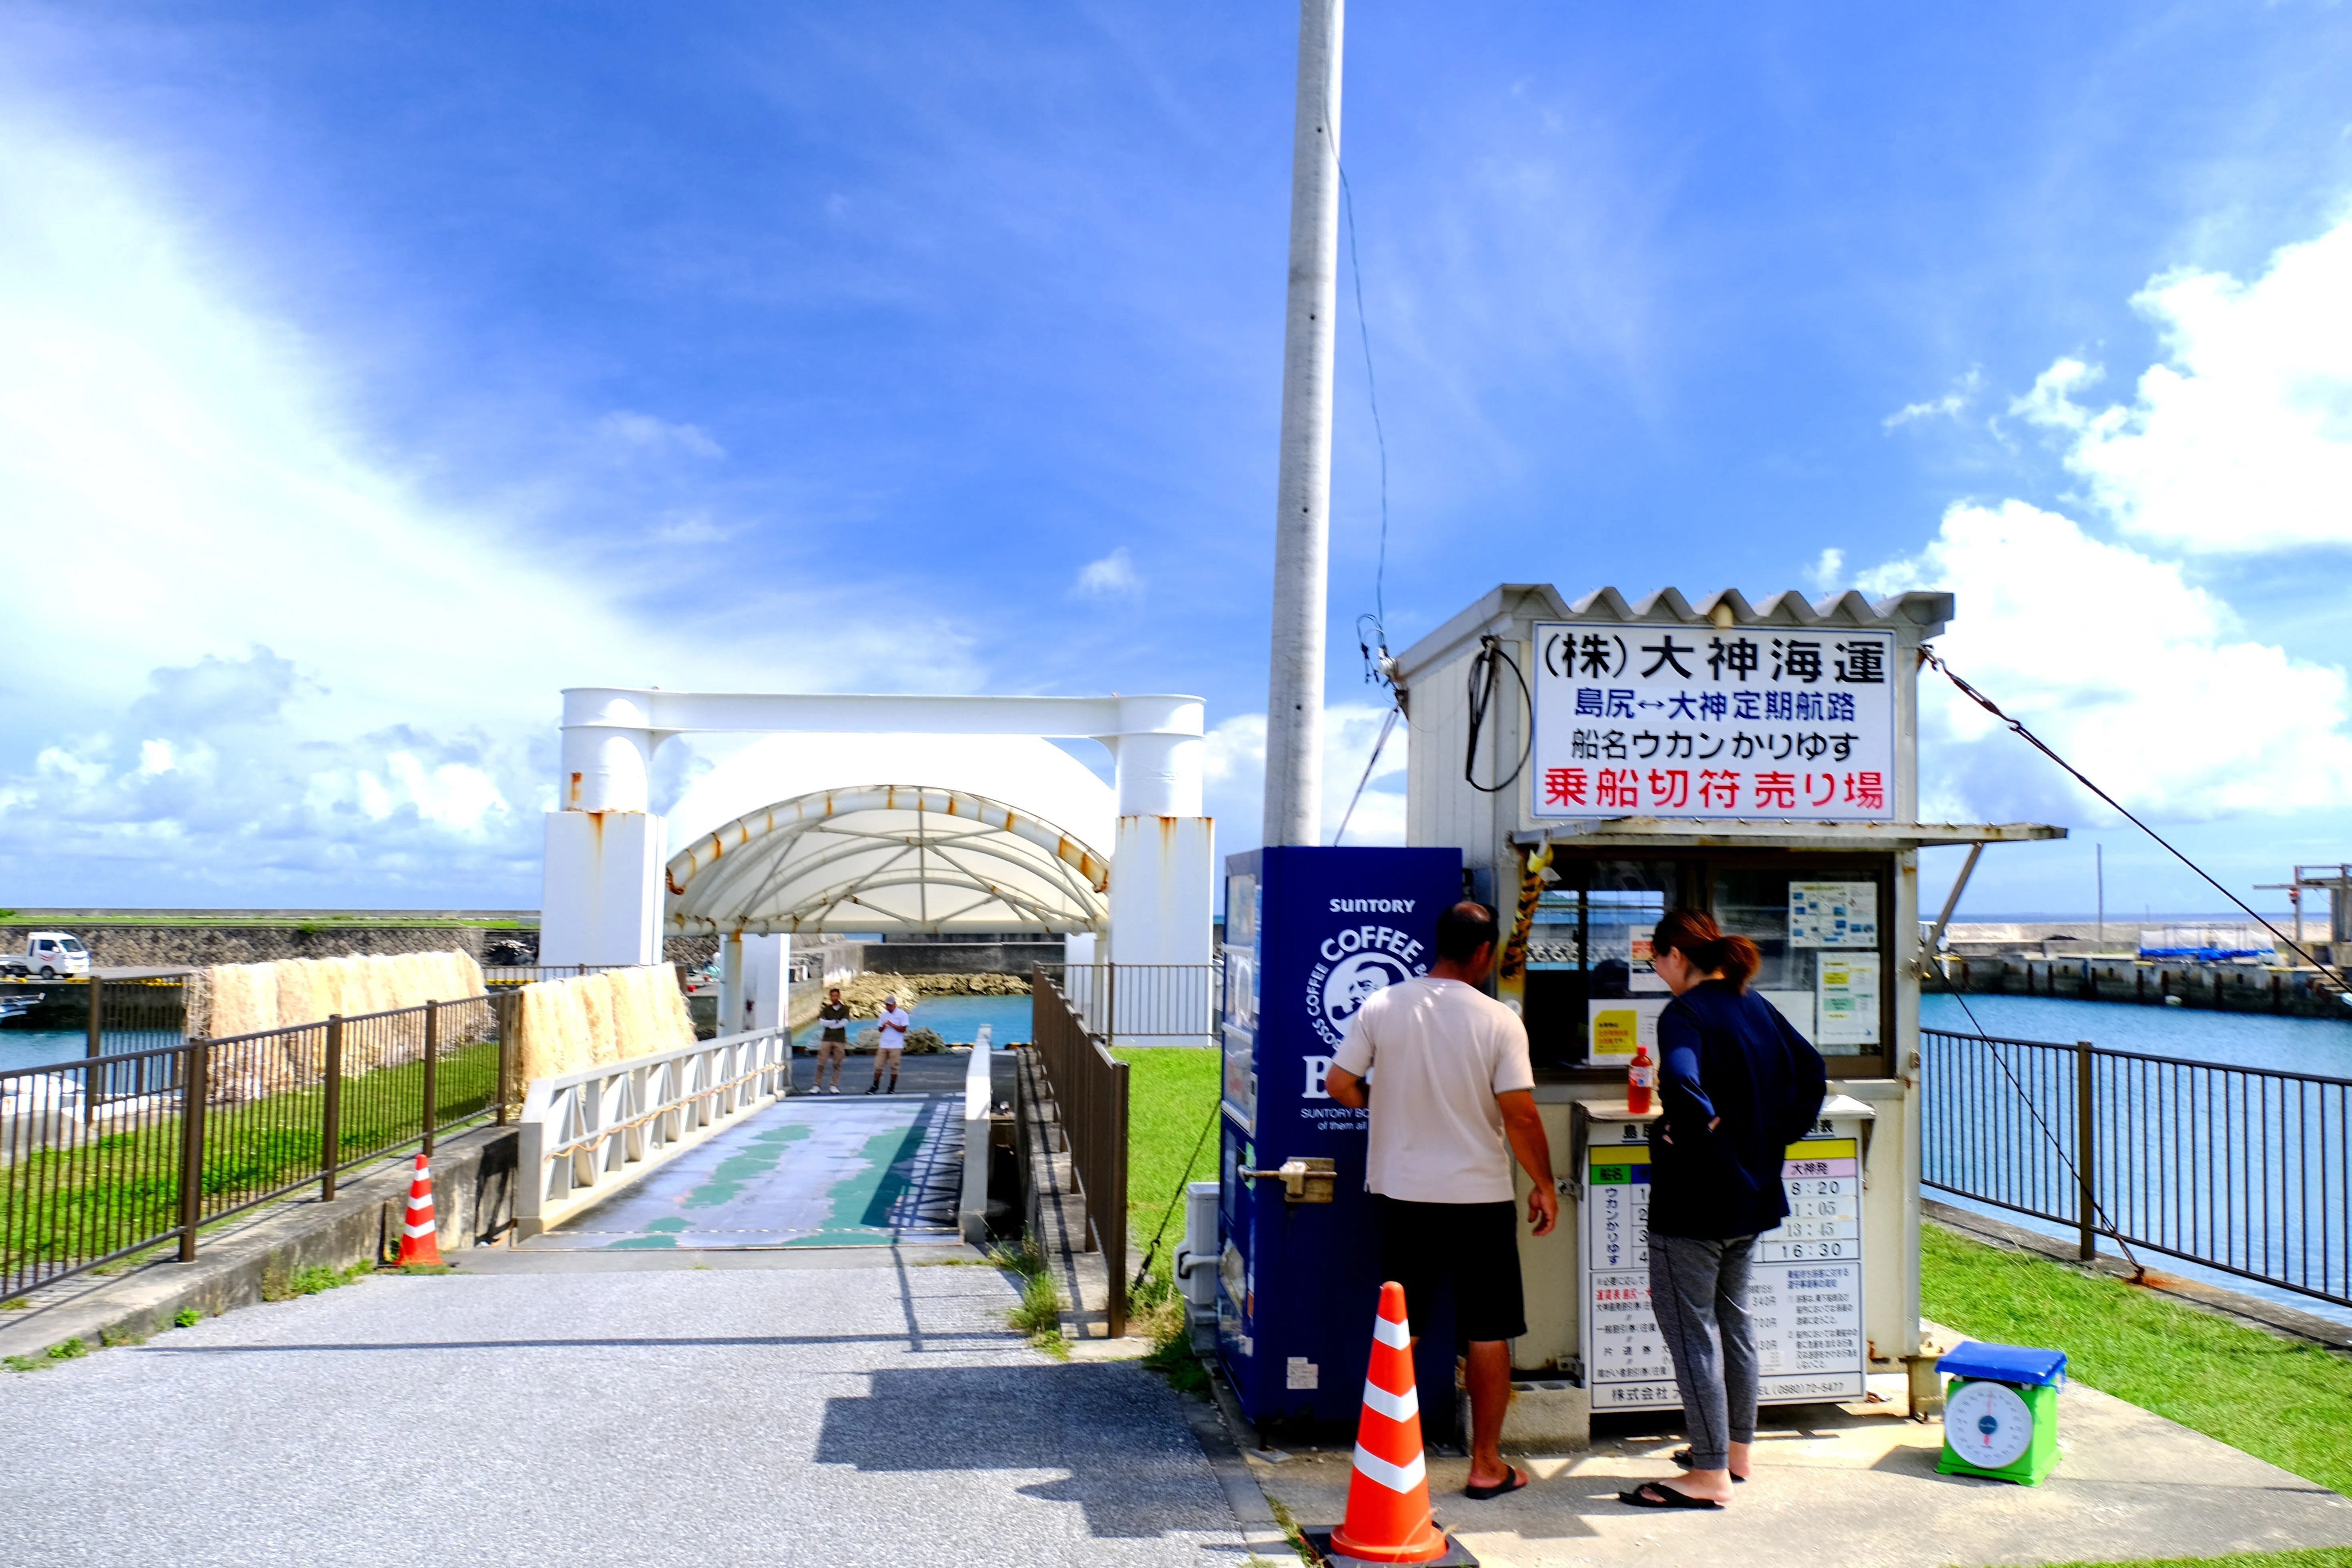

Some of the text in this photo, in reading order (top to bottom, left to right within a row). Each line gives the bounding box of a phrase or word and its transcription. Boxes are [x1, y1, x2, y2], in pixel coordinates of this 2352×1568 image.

[1544, 767, 1884, 809] 乗船切符売り場
[1329, 898, 1416, 913] SUNTORY
[1320, 925, 1425, 964] COFFEE
[1306, 962, 1329, 1016] COFFEE
[1301, 1108, 1353, 1118] SUNTORY
[1317, 1120, 1367, 1130] of them all
[1605, 1187, 1620, 1266] ウカンかりゆす
[1782, 1243, 1841, 1259] 16:30
